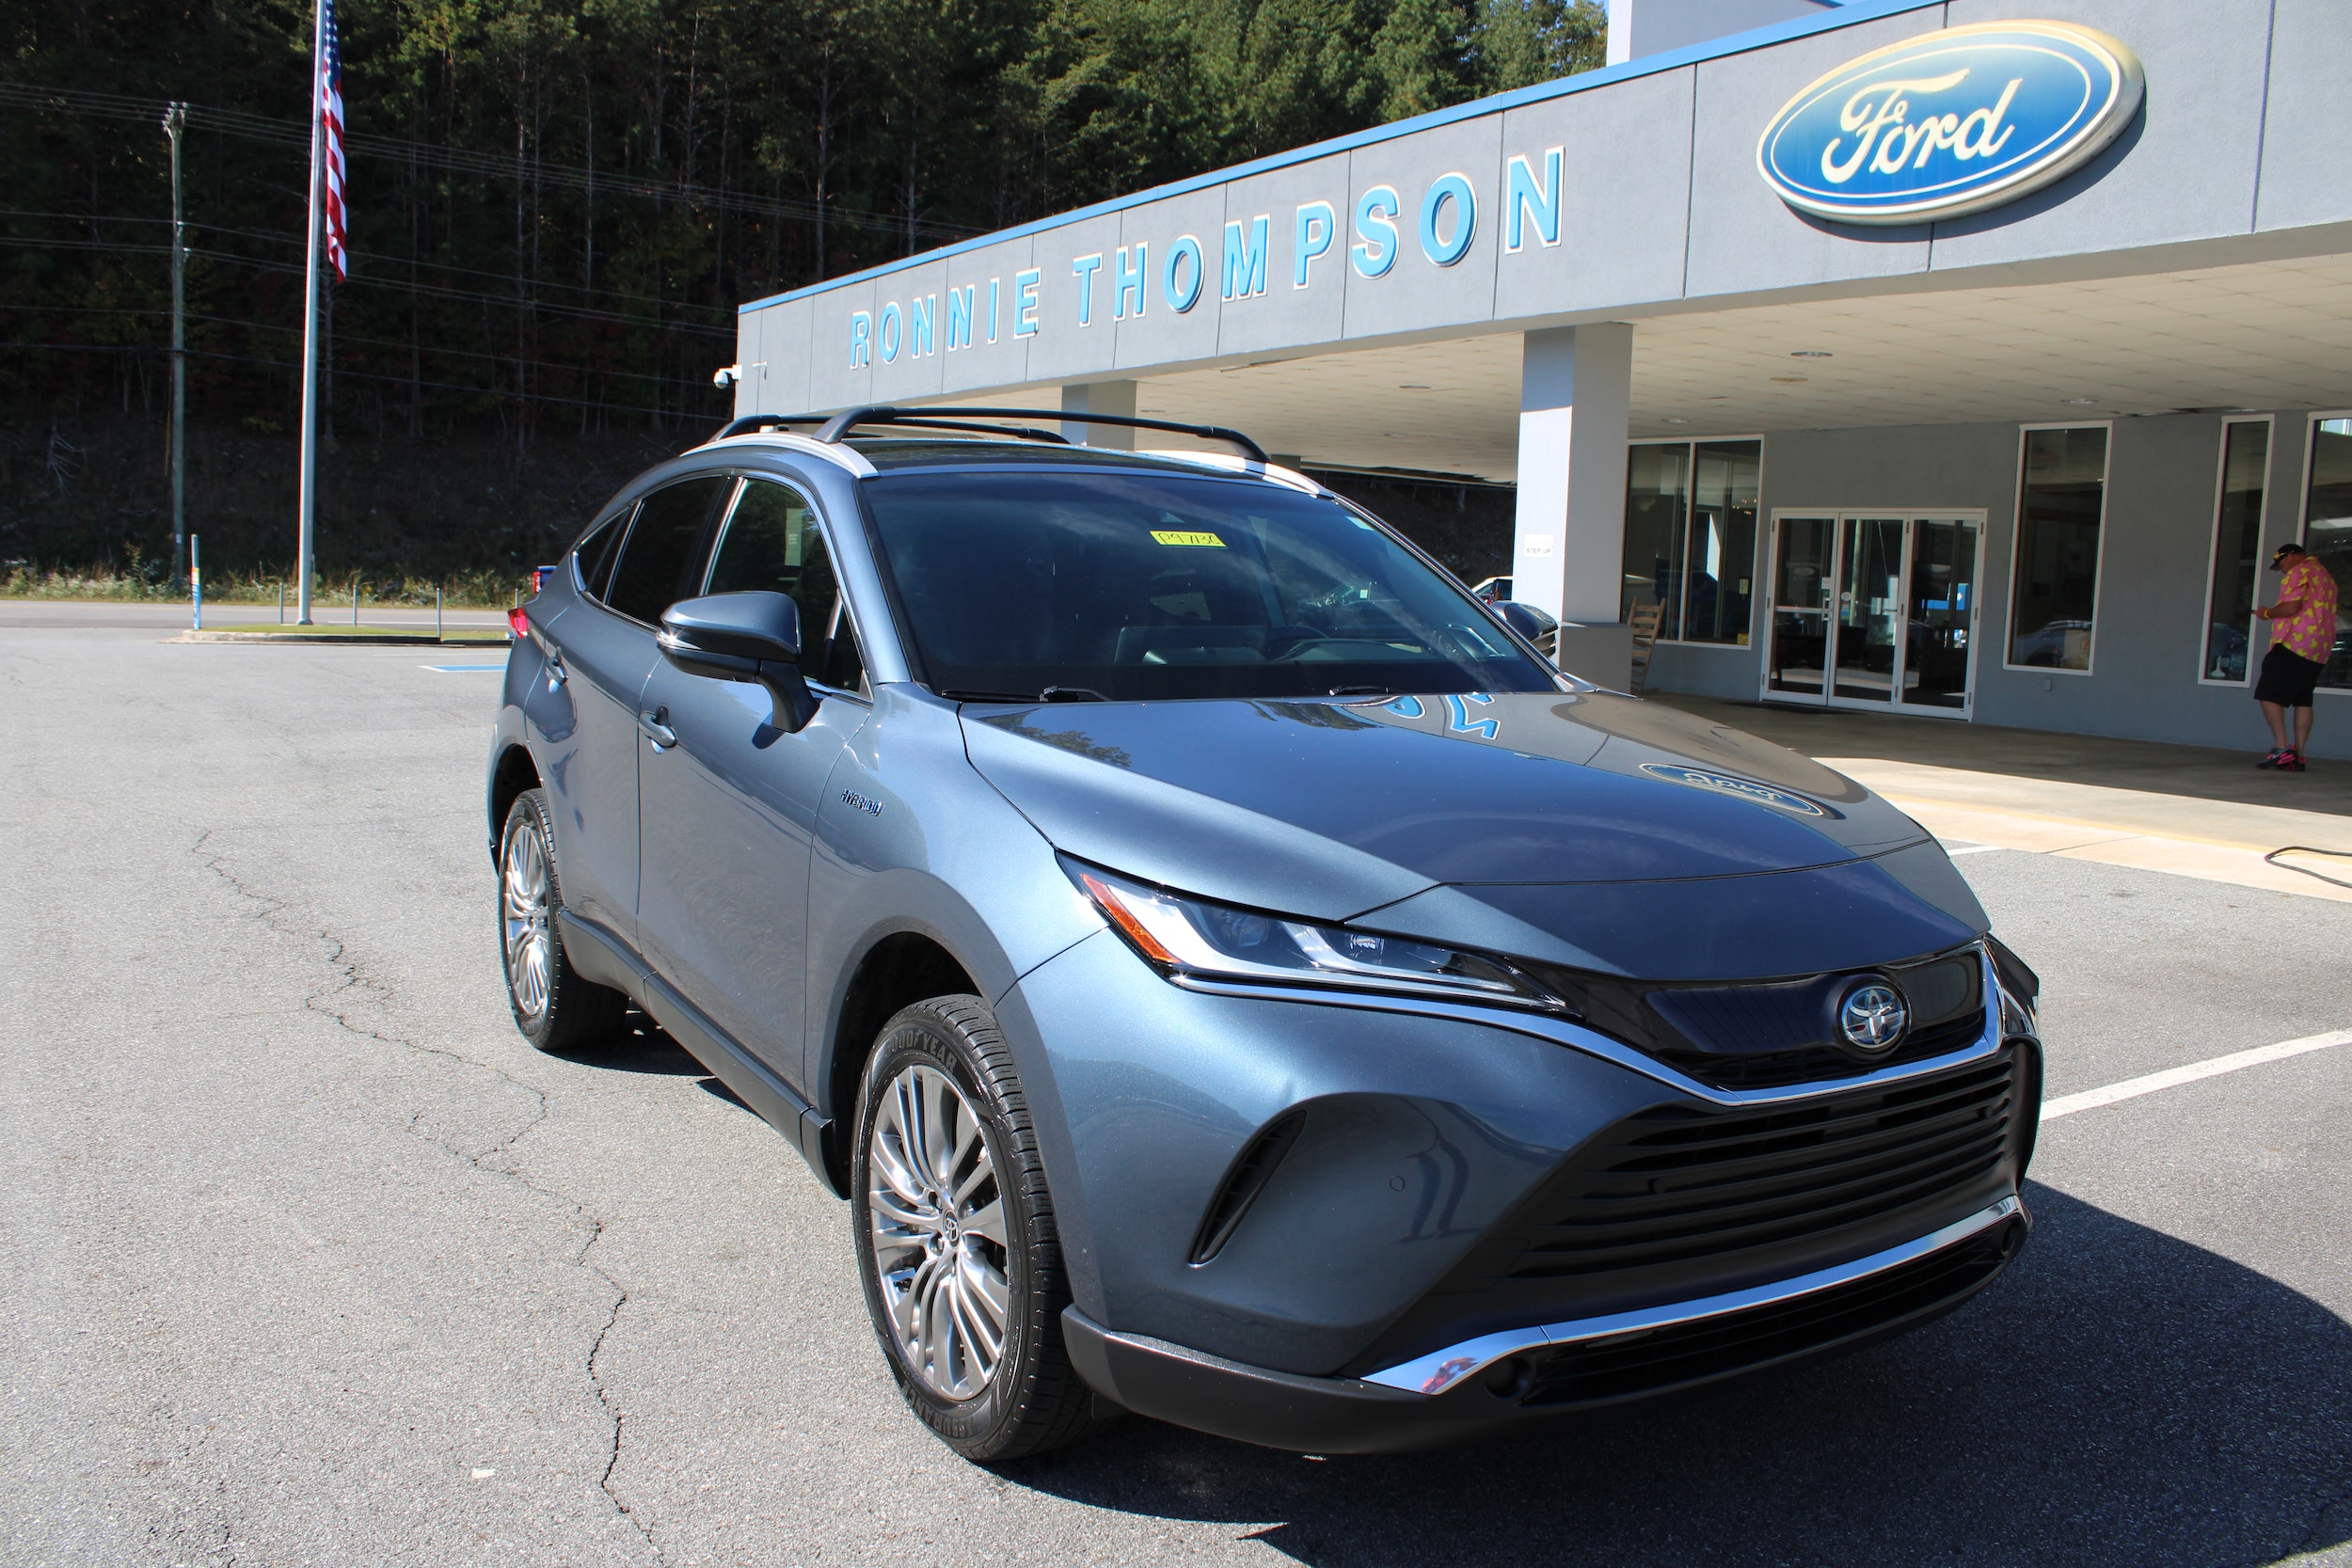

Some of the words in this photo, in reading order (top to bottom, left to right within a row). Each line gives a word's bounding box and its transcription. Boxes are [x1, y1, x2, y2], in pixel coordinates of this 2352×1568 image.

[1821, 68, 2023, 183] Ford
[850, 267, 1041, 370] RONNIE
[1073, 145, 1565, 327] THOMPSON
